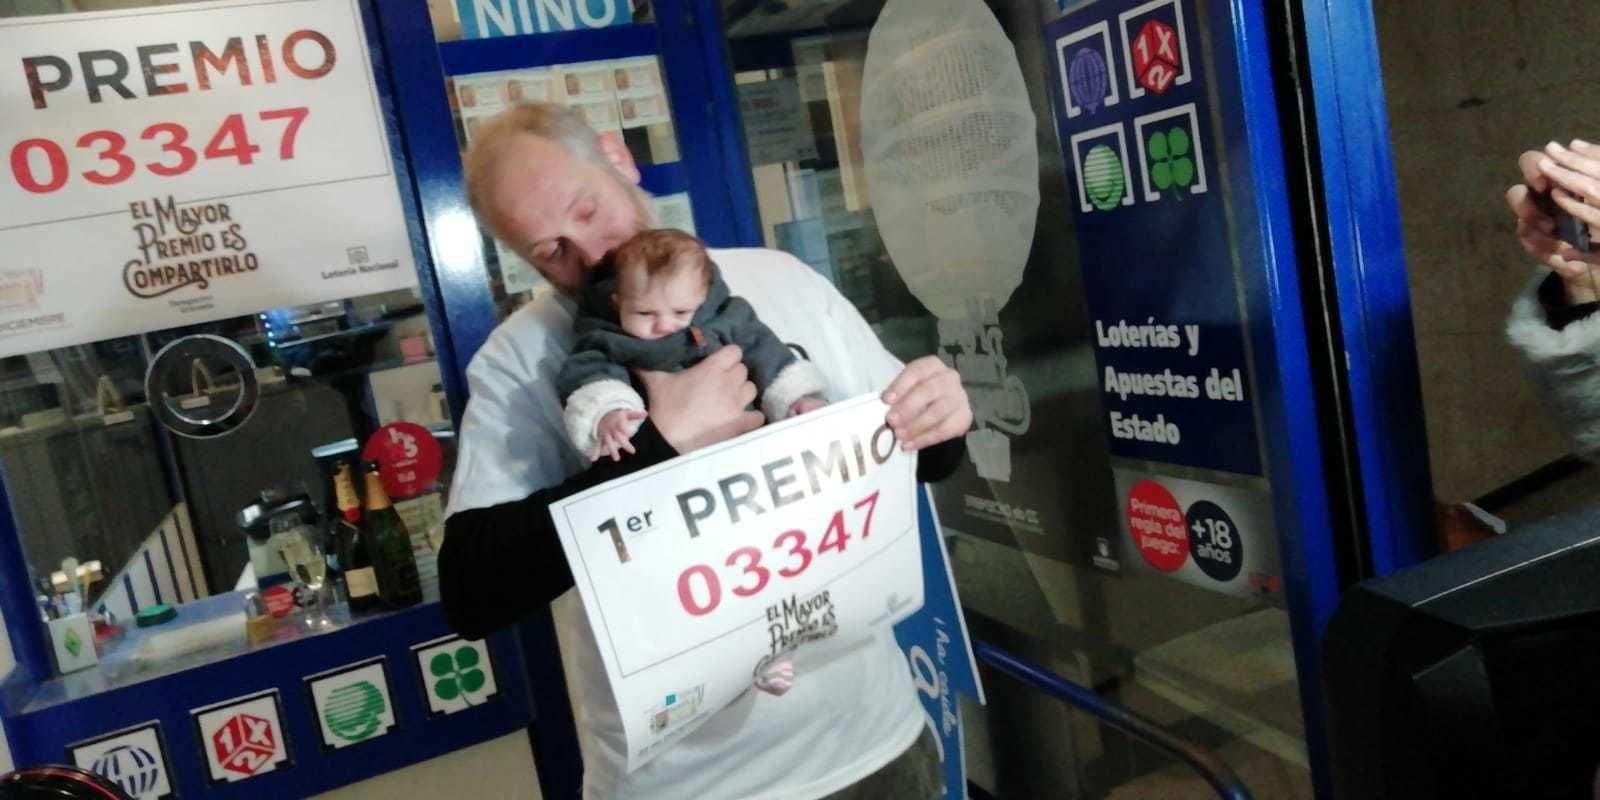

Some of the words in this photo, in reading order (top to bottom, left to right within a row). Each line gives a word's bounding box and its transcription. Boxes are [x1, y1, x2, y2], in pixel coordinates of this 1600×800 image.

[22, 29, 336, 109] PREMIO
[10, 106, 309, 194] 03347
[129, 200, 153, 220] EL
[153, 195, 232, 235] MAYOR
[133, 223, 215, 264] PREMIO
[220, 223, 247, 251] ES
[123, 252, 258, 299] COMPARTIRLO
[1095, 317, 1180, 349] Loterías
[1184, 322, 1200, 356] y
[1104, 366, 1199, 400] Apuestas
[1205, 367, 1244, 401] del
[1110, 411, 1180, 445] Estado
[675, 422, 898, 539] PREMIO
[1130, 497, 1181, 522] Primera
[1130, 517, 1164, 534] regla
[1165, 523, 1185, 538] del
[676, 489, 881, 617] 03347
[1191, 518, 1232, 550] +18
[1197, 543, 1232, 564] años
[766, 605, 781, 622] EL
[782, 590, 831, 630] MAYOR
